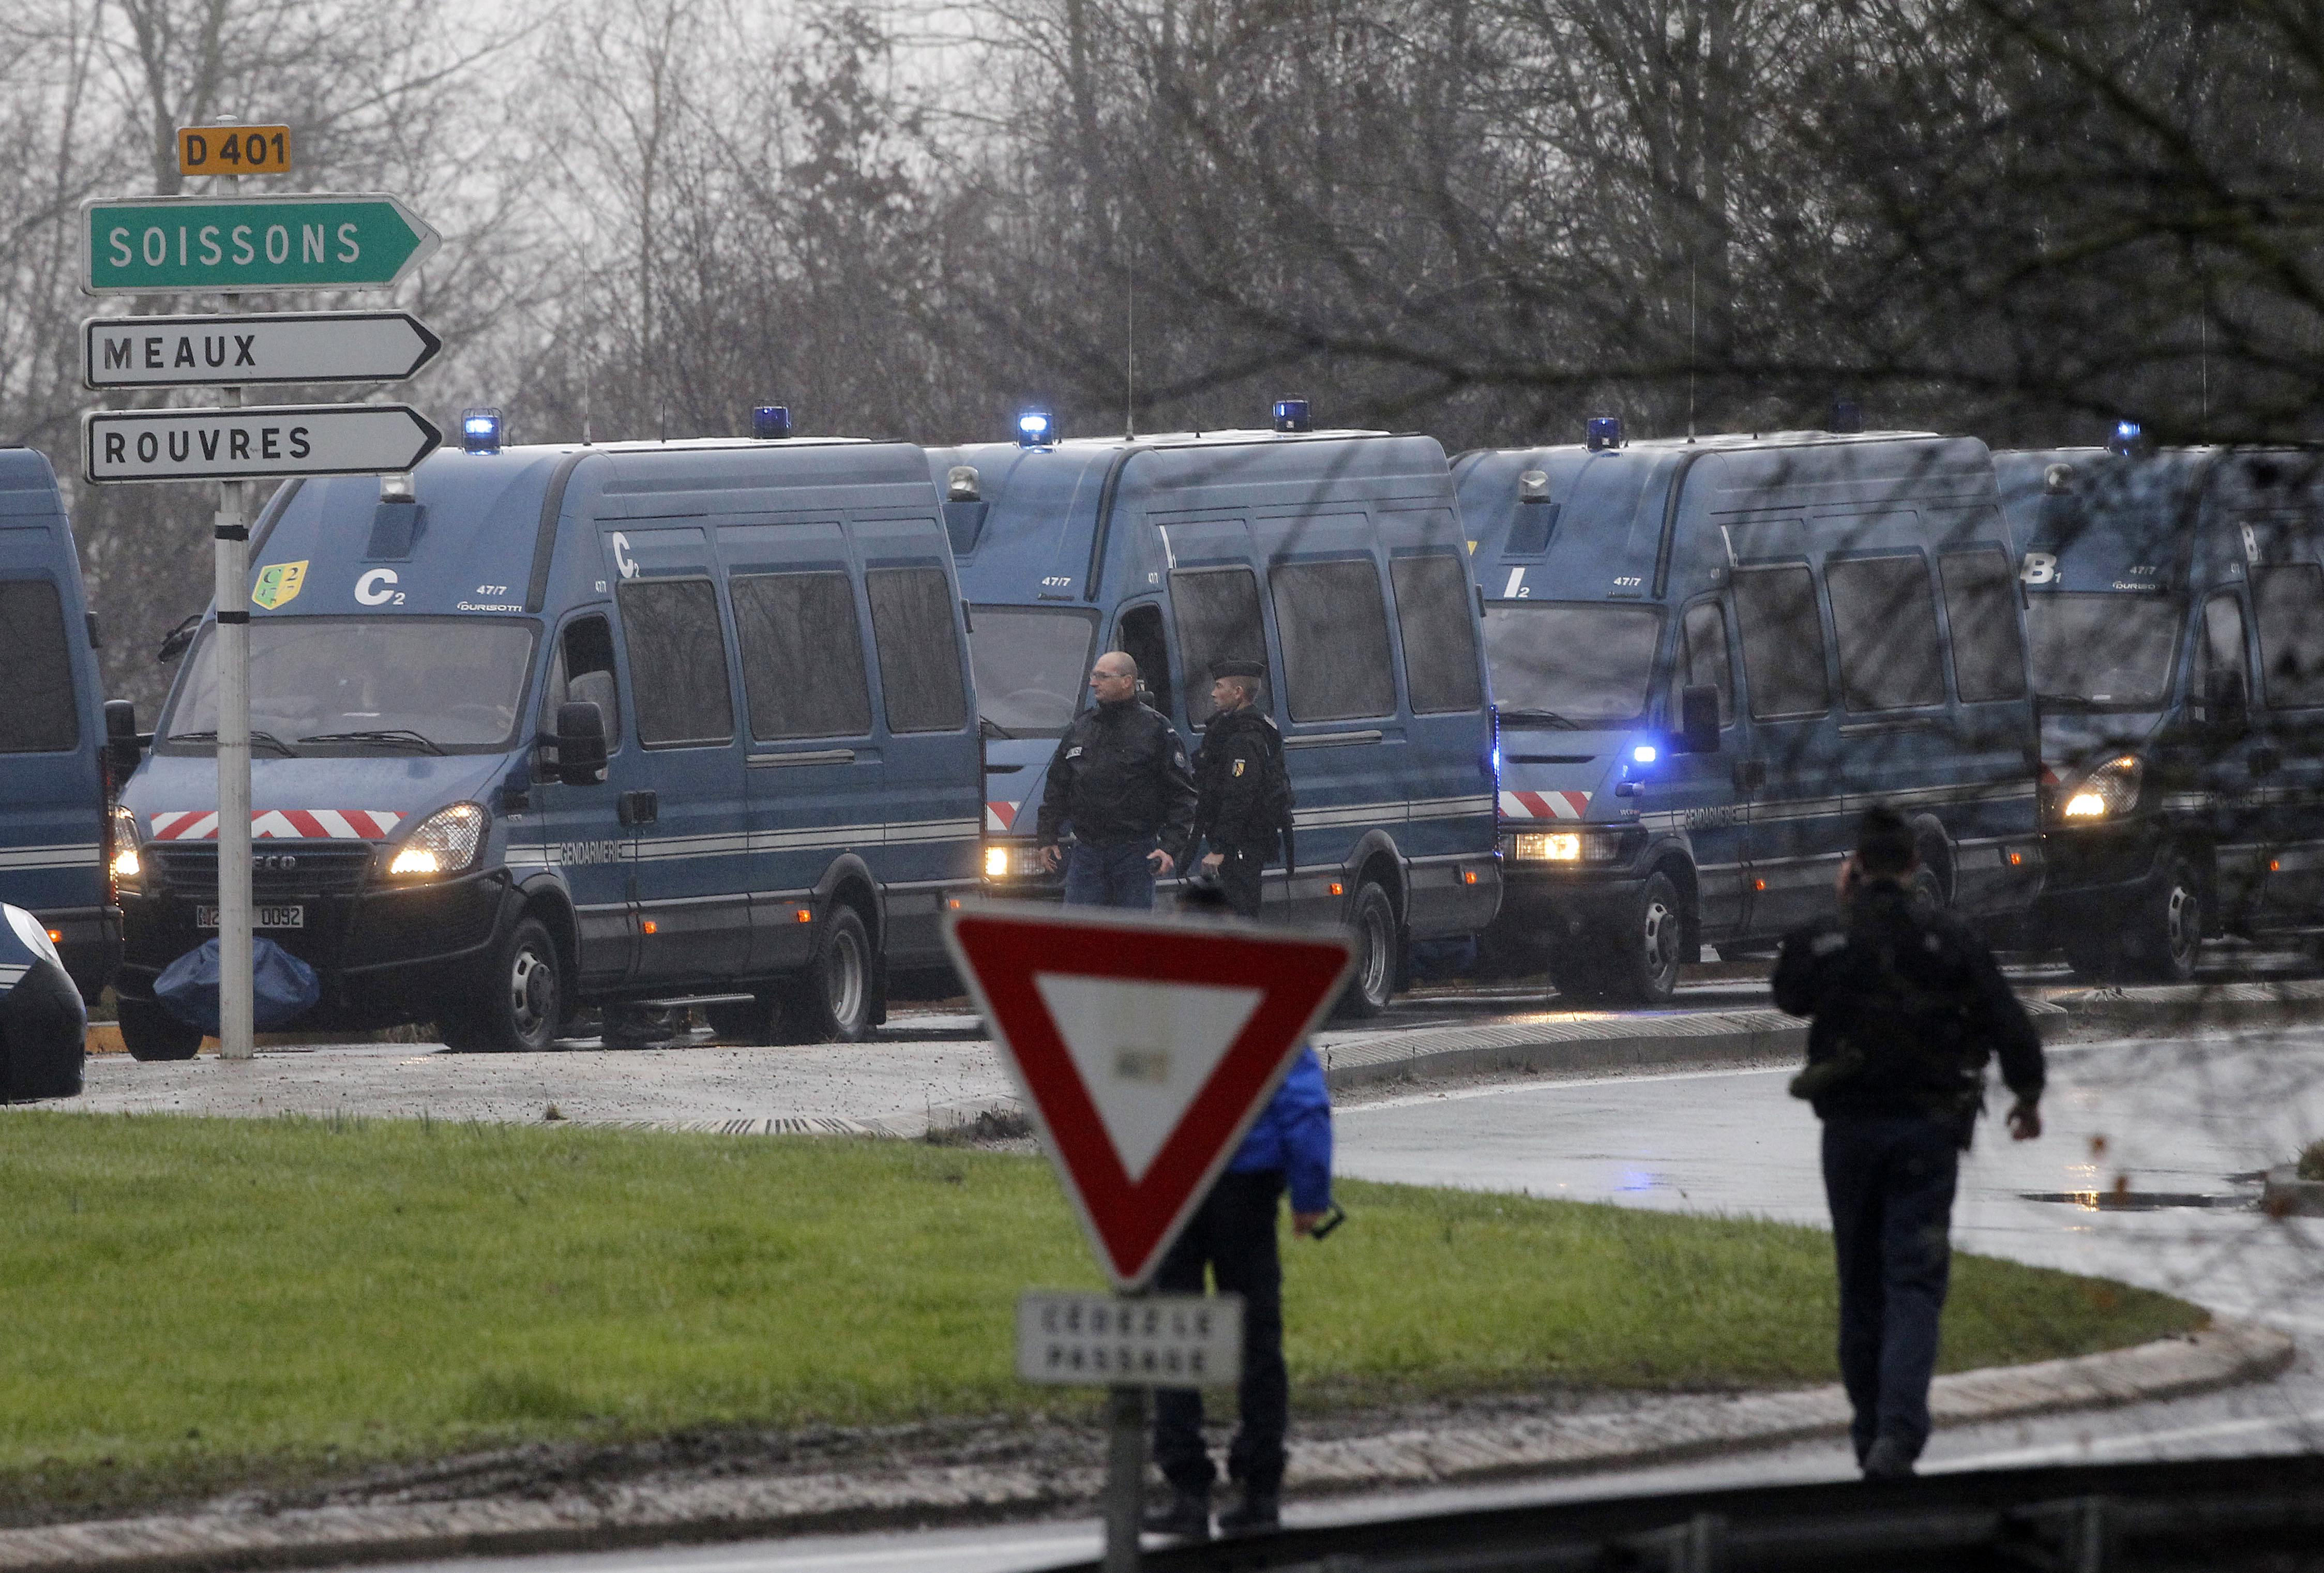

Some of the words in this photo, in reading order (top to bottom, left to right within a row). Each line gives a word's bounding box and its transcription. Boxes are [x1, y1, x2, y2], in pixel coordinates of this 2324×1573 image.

[187, 135, 207, 165] D
[219, 133, 285, 165] 401
[109, 223, 360, 267] SOISSONS
[104, 335, 256, 369] MEAUX
[105, 427, 311, 463] ROUVRES
[476, 585, 507, 595] 47/7
[1042, 577, 1071, 586] 47/7
[1613, 577, 1641, 586] 47/7
[252, 856, 296, 870] ECO
[560, 840, 622, 866] GENDARMERIE
[262, 908, 300, 926] 0092
